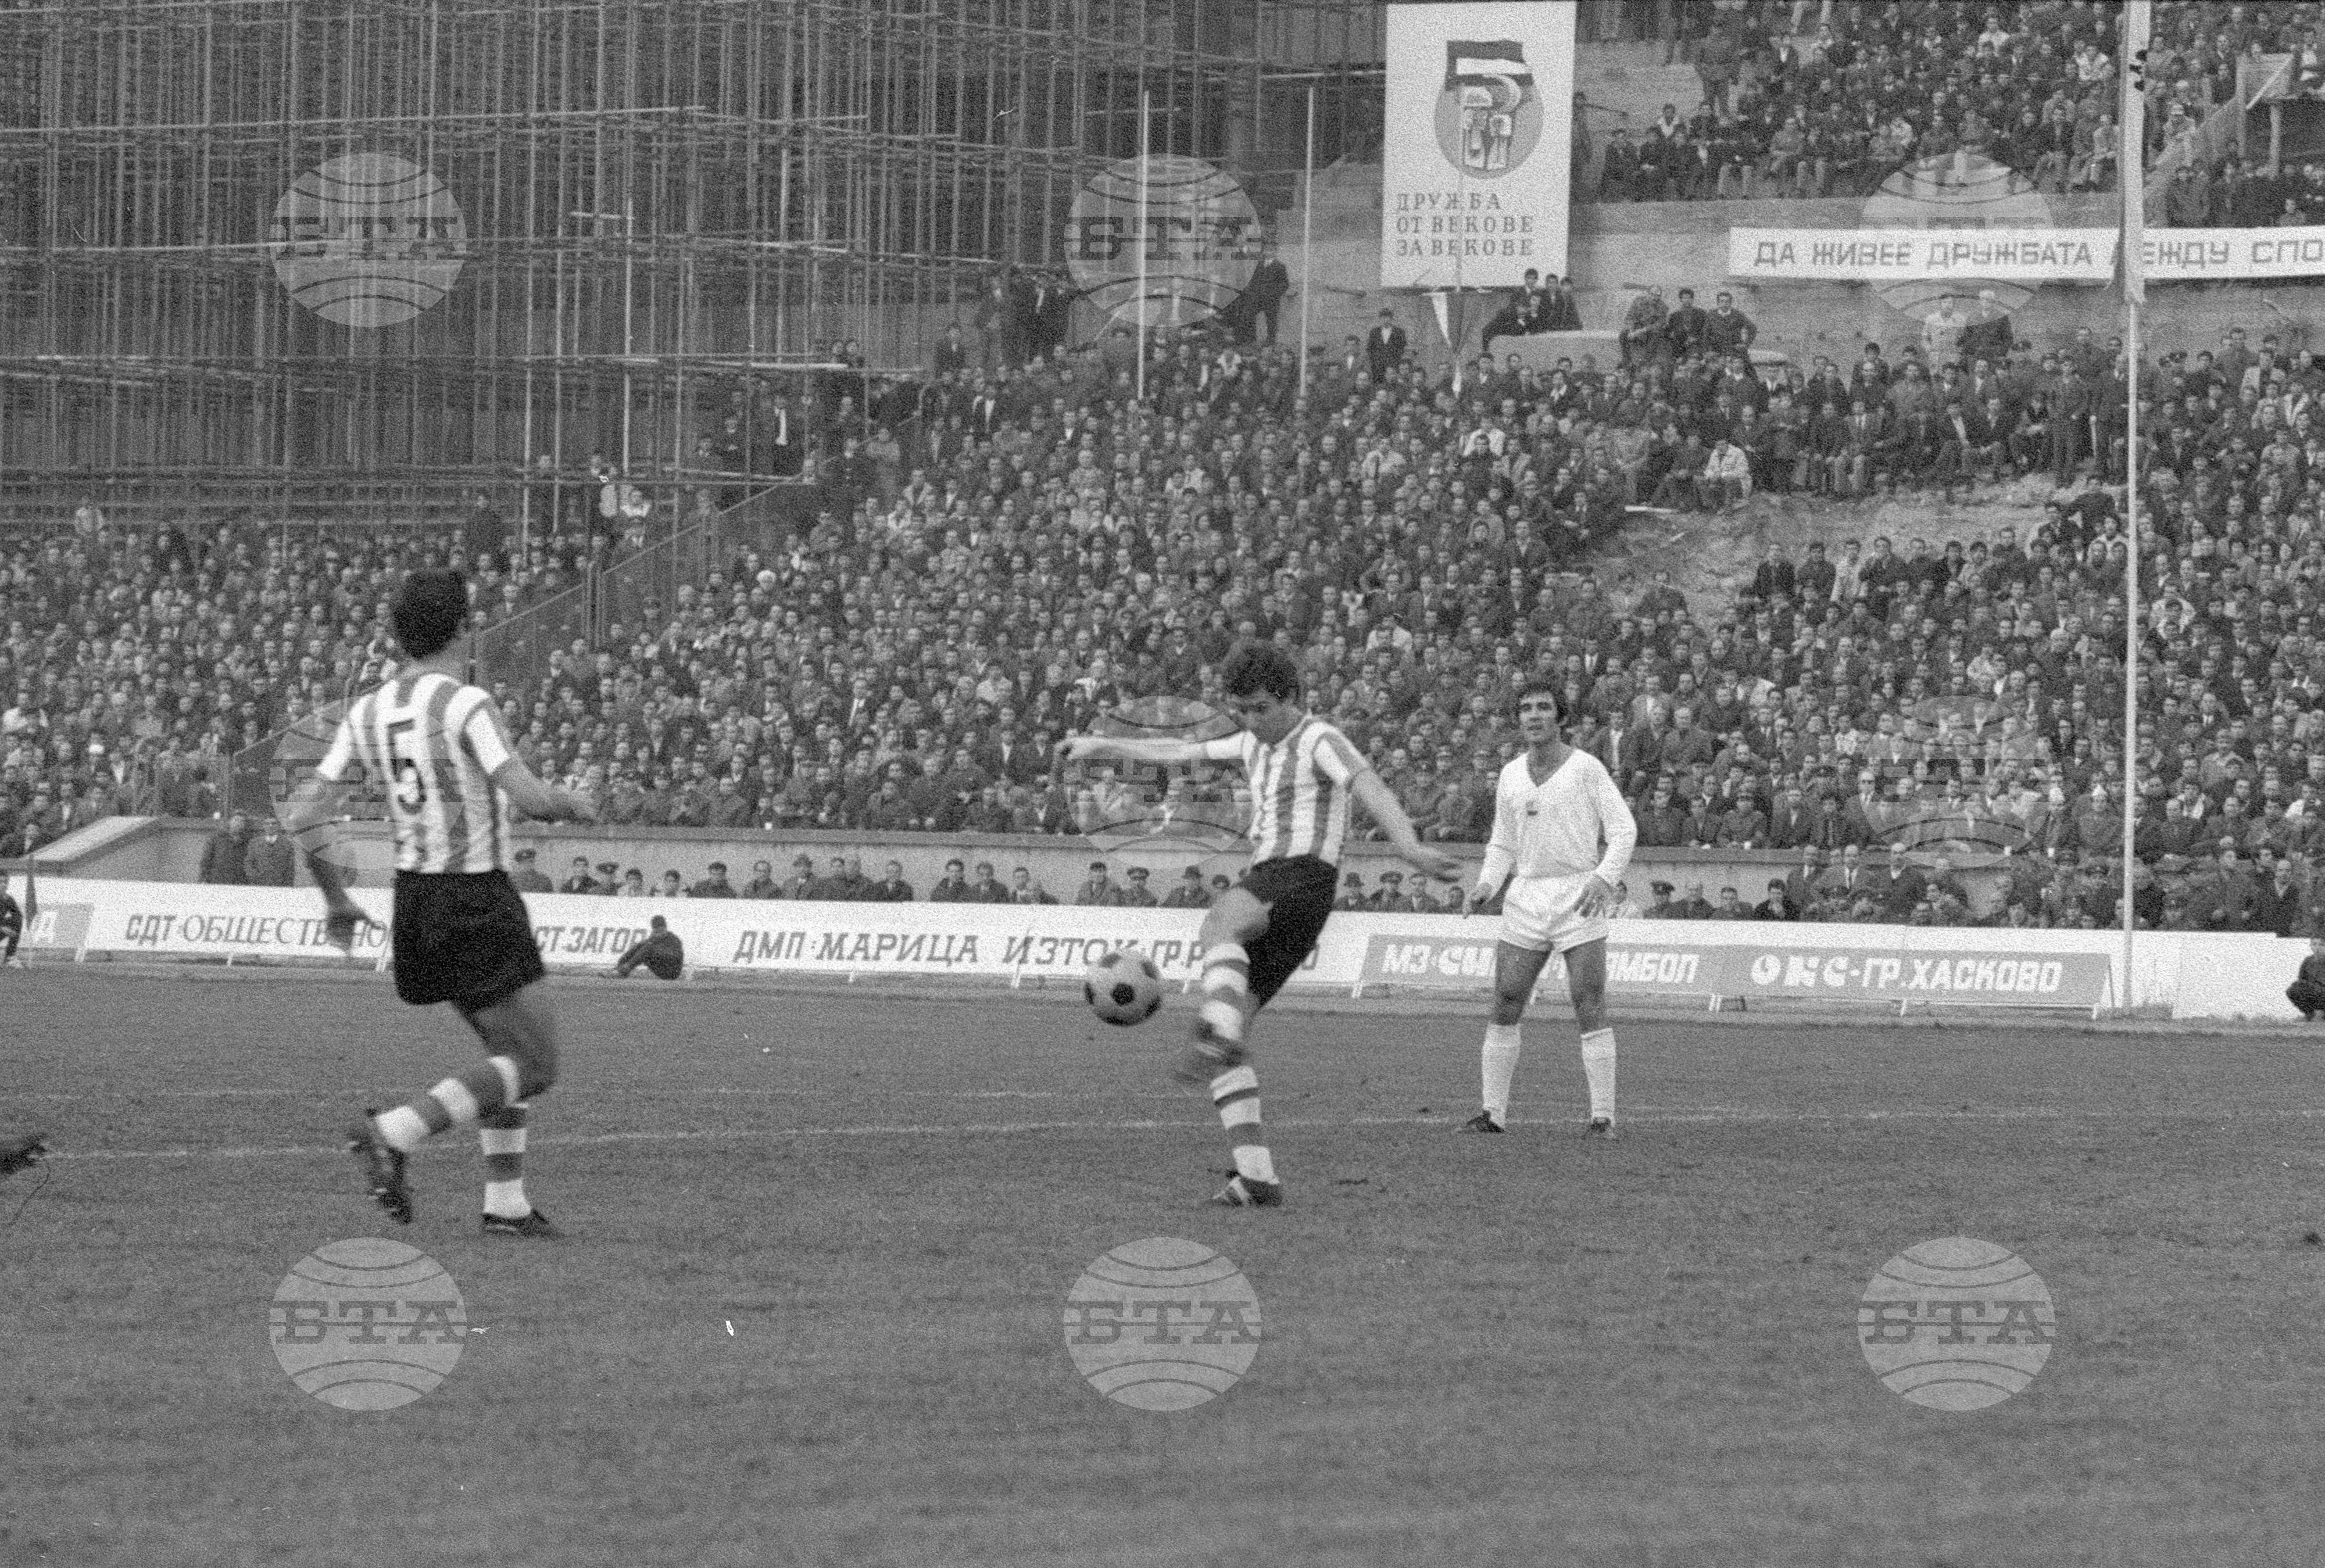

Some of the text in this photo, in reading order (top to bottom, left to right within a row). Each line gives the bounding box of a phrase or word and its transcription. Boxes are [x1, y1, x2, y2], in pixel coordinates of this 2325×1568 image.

[1396, 193, 1501, 212] ДРУЖБА
[1396, 216, 1534, 233] ОТ ВЕКОВЕ
[1396, 238, 1533, 256] ЗА ВЕКОВЕ
[1754, 241, 1795, 267] ДА
[1812, 242, 1911, 266] ЖИВЕЕ
[1927, 242, 2092, 269] ДРУЖБАТА
[2109, 241, 2229, 269] ЕЖДУ
[387, 718, 427, 814] 5
[1001, 935, 1138, 966] ИЗТО
